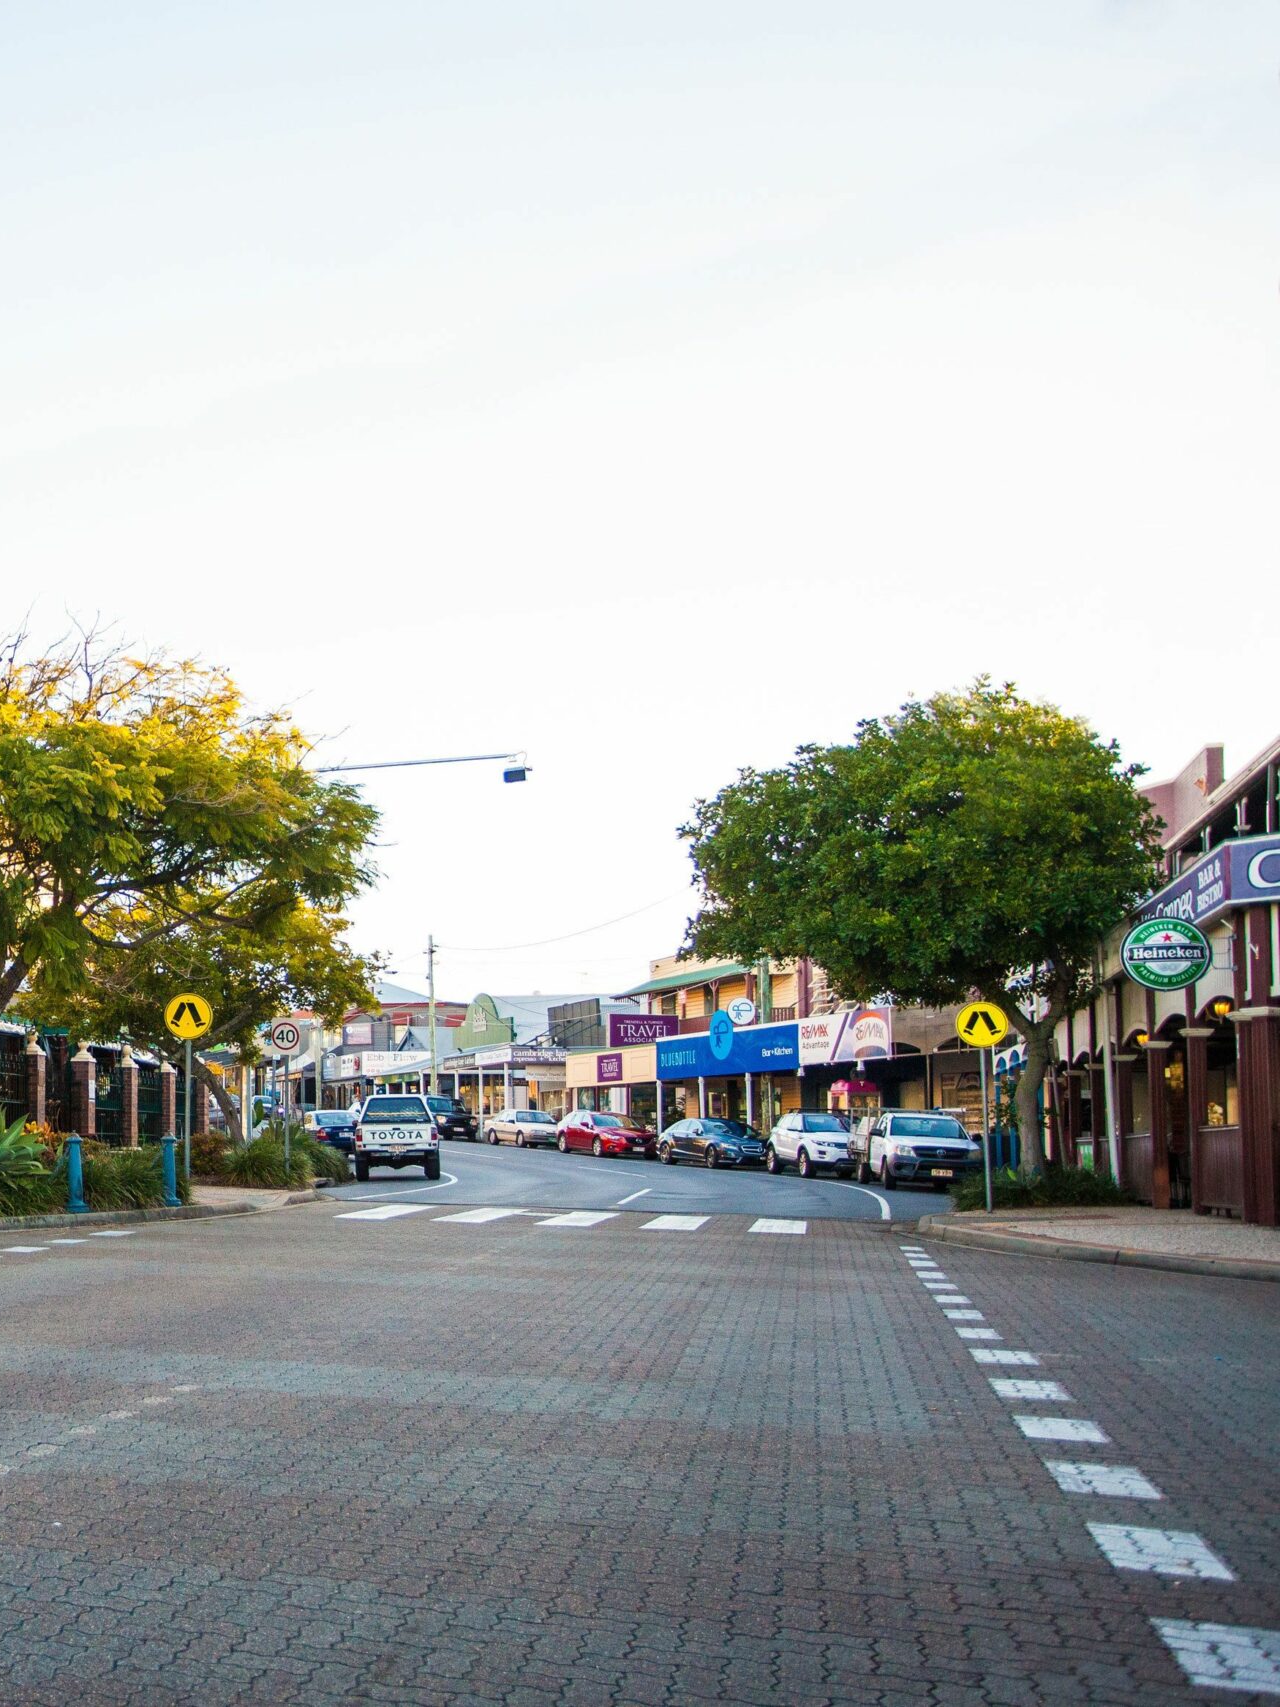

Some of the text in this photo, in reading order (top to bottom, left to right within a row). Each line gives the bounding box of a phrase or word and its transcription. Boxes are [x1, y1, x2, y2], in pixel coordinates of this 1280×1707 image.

[1198, 859, 1221, 890] BAR &
[1197, 880, 1224, 912] BISTRO
[1139, 923, 1193, 939] HEINEKEN BEER
[1133, 946, 1202, 960] Heineken
[1138, 966, 1198, 983] PREMIUM QUALITY
[276, 1029, 295, 1043] 40
[801, 1024, 828, 1039] RE/MAX
[513, 1049, 554, 1058] cambridge
[660, 1050, 696, 1067] BLUEBOTTLE
[370, 1131, 423, 1140] TOYOTA
